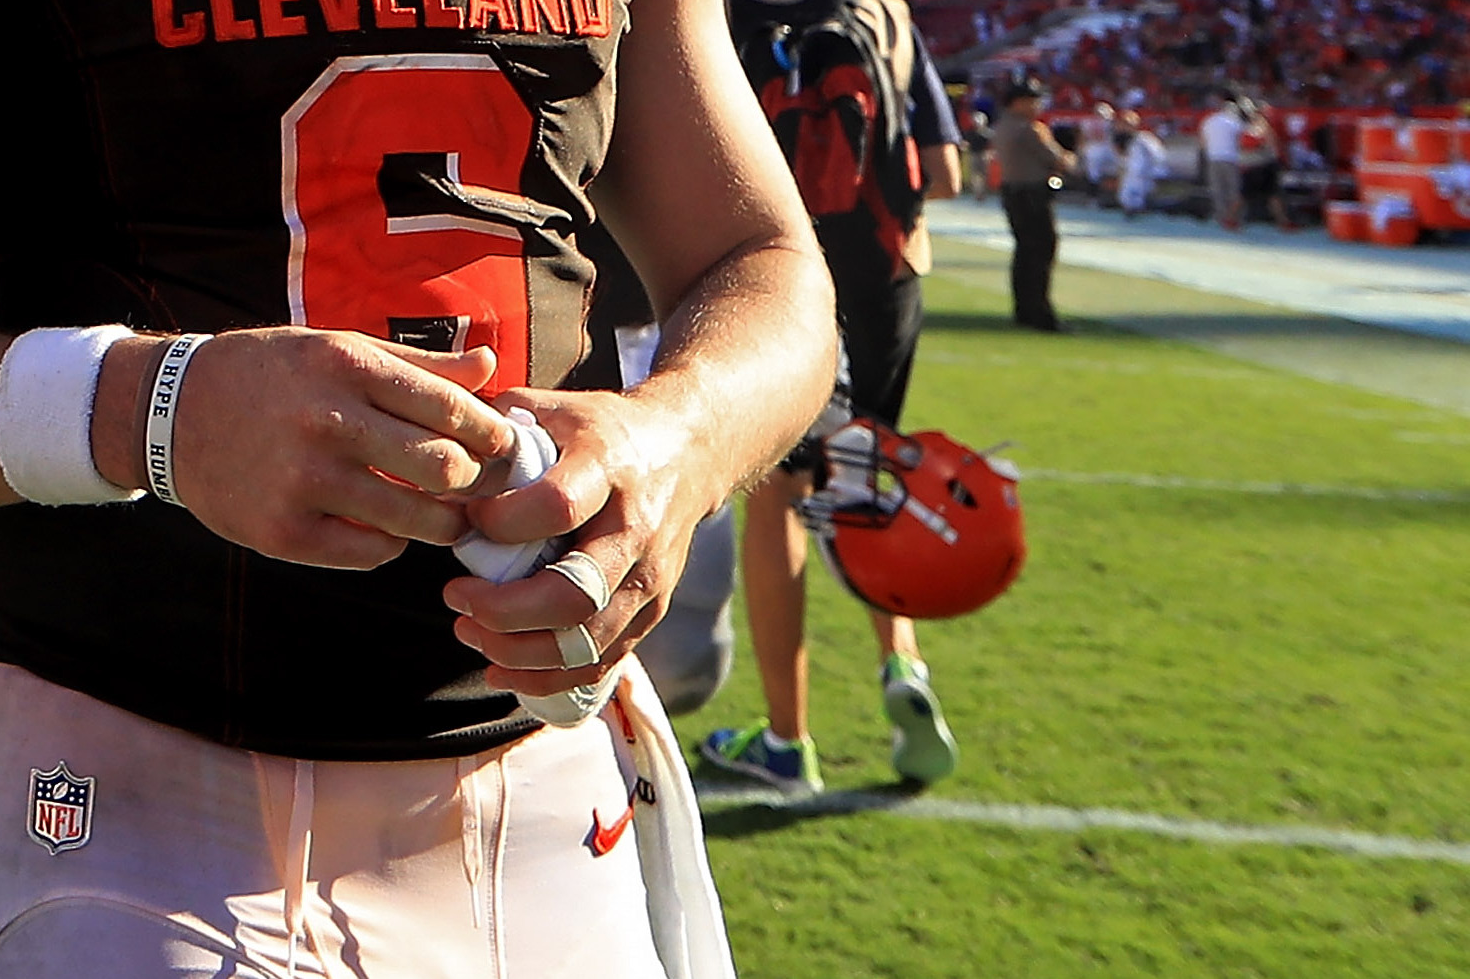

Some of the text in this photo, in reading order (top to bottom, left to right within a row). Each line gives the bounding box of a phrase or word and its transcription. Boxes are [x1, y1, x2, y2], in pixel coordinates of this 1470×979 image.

[280, 53, 533, 392] 6
[152, 364, 180, 419] HYPE
[38, 802, 81, 840] NFL
